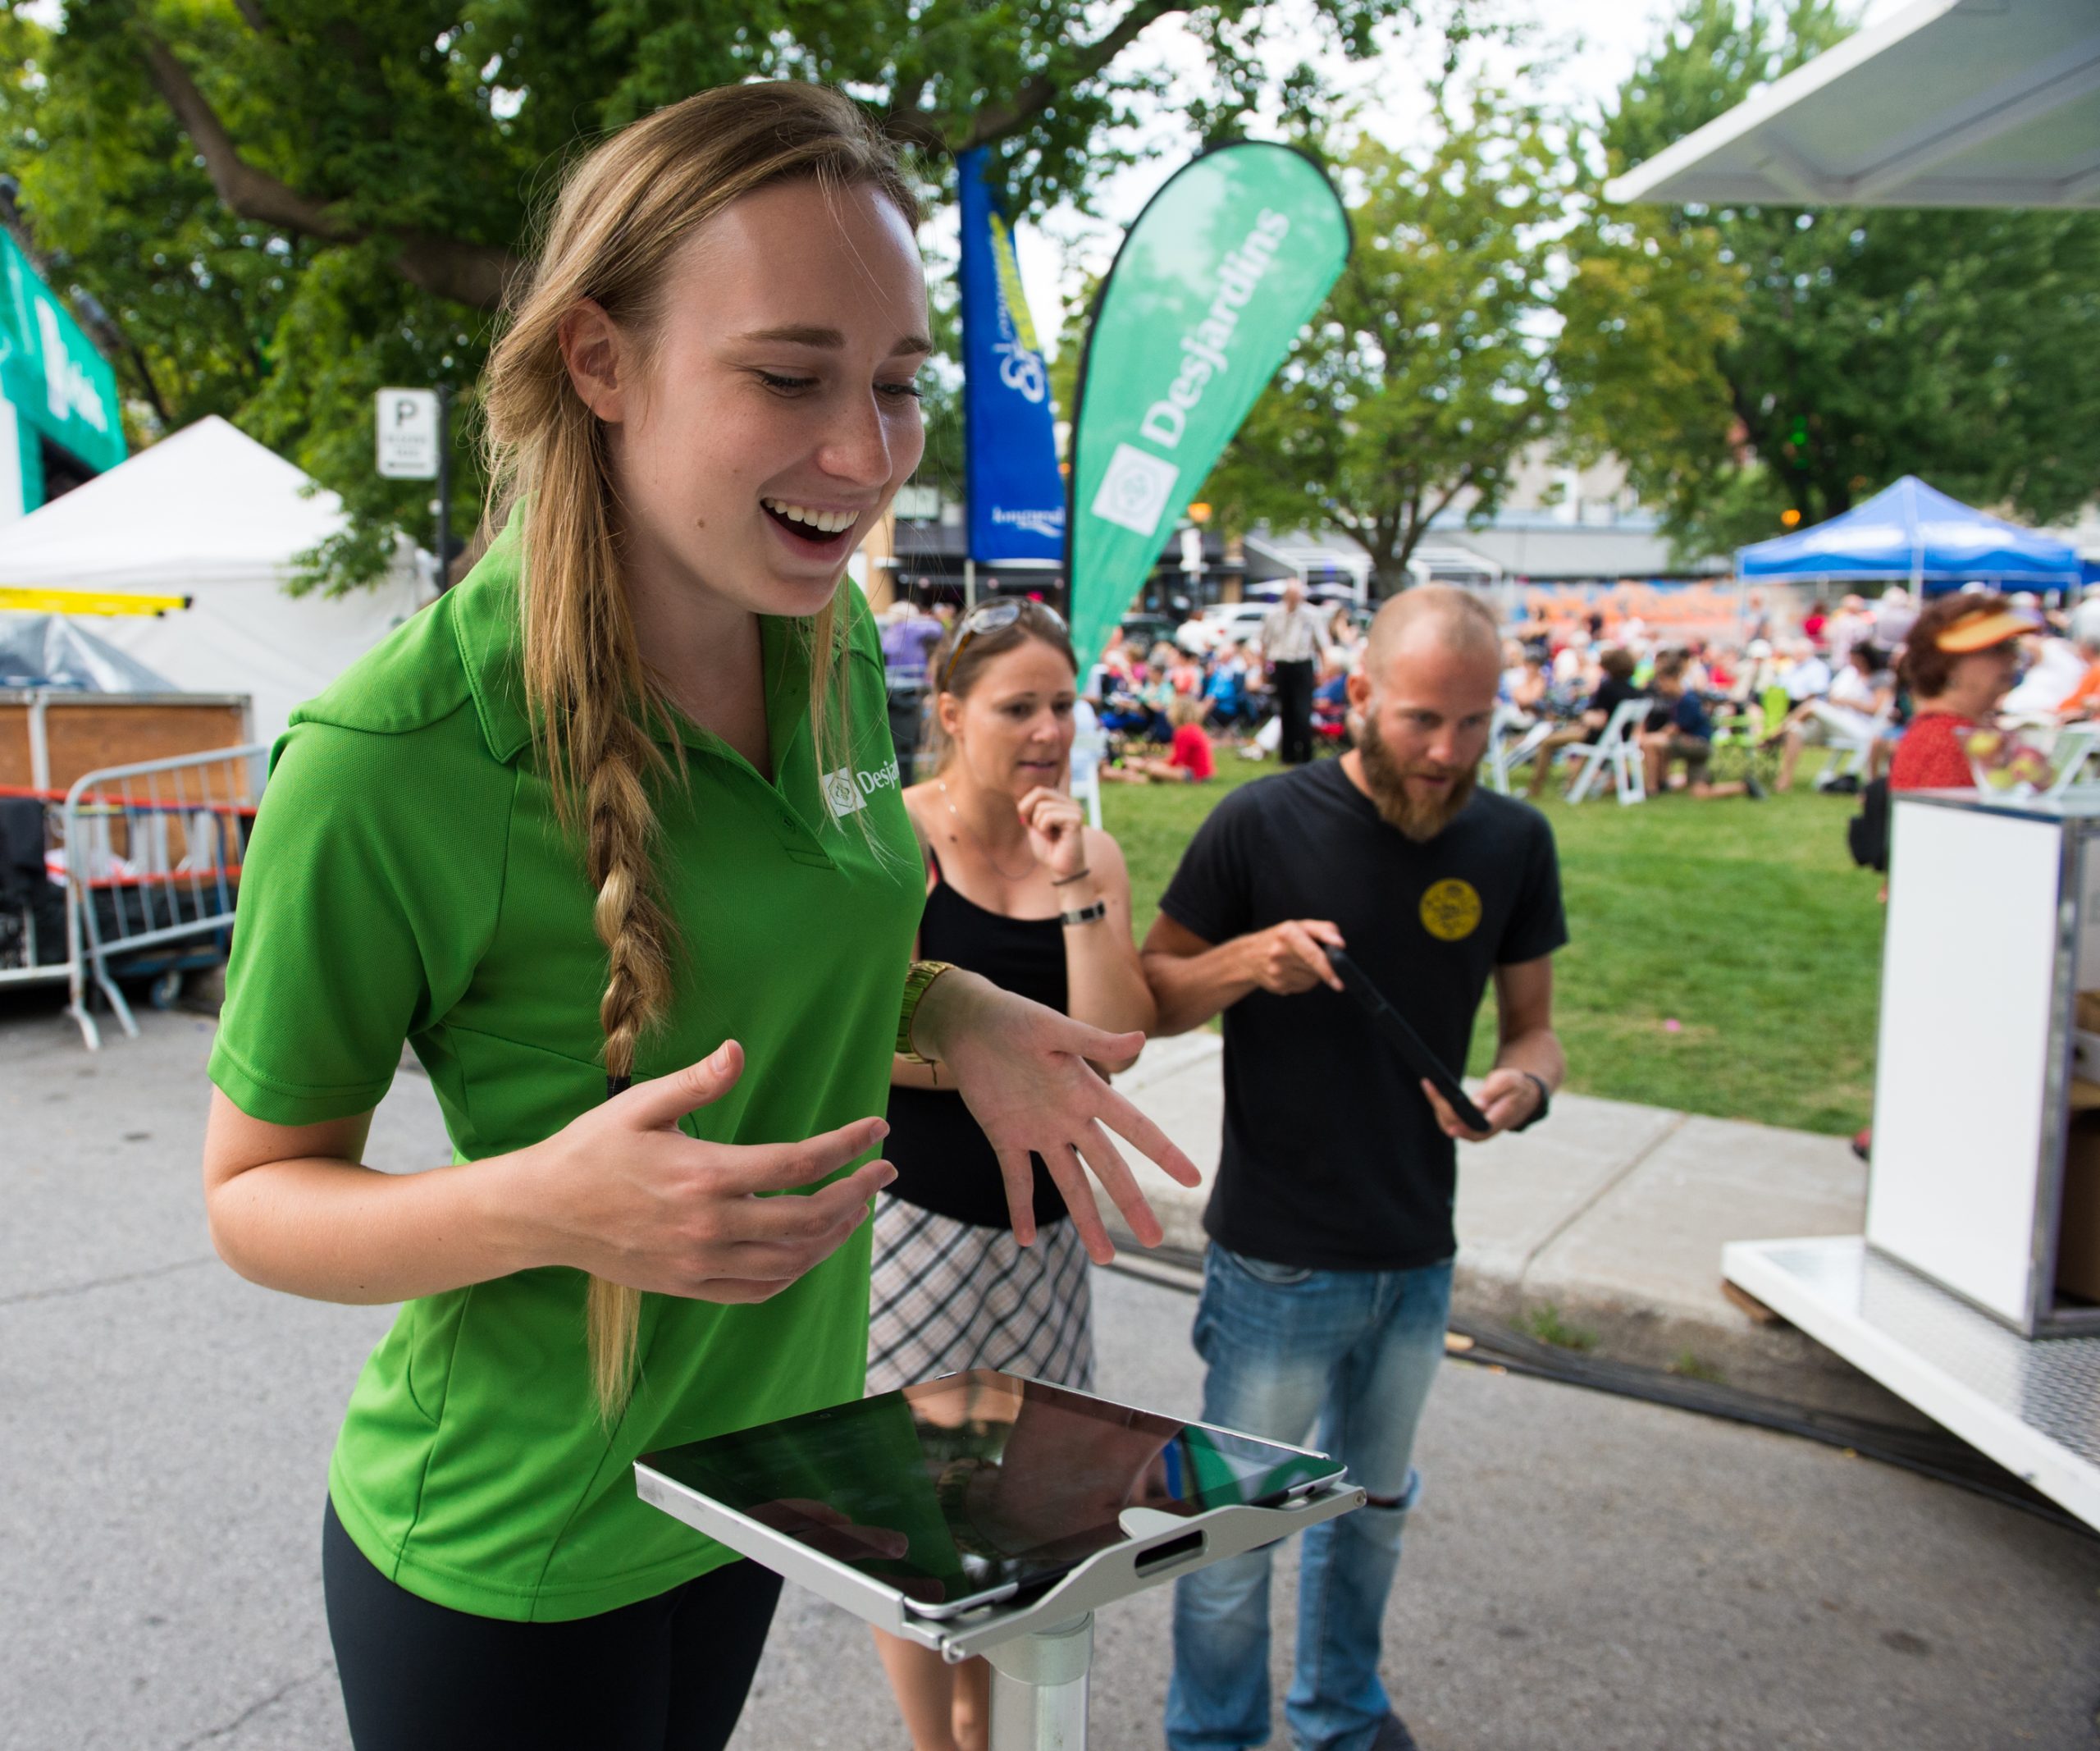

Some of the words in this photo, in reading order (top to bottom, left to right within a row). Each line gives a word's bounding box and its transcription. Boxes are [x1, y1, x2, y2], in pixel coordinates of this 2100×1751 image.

[1139, 207, 1290, 449] Desjardins
[395, 399, 419, 427] P
[856, 755, 900, 794] Desja
